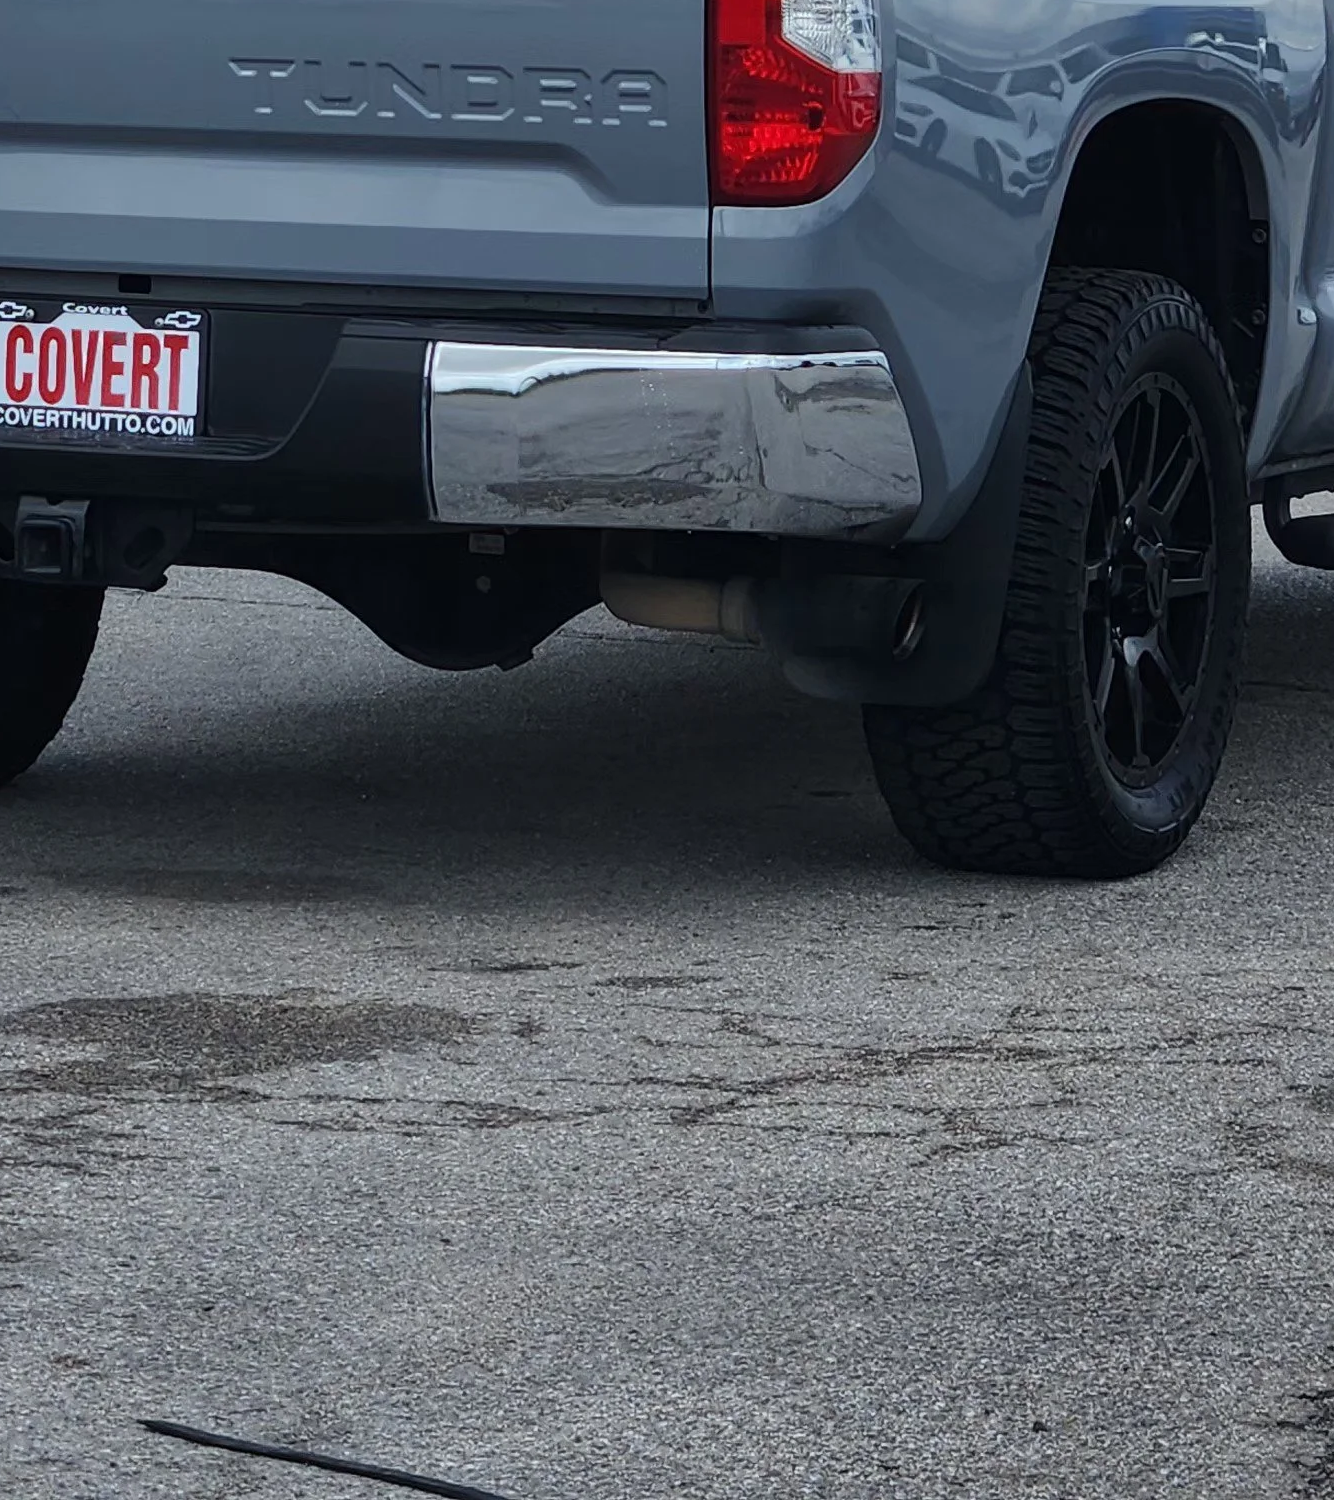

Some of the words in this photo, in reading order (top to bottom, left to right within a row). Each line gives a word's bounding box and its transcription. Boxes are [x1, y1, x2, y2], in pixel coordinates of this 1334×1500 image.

[228, 57, 667, 127] TUNDRA
[62, 302, 129, 316] Covert
[5, 324, 190, 411] COVERT
